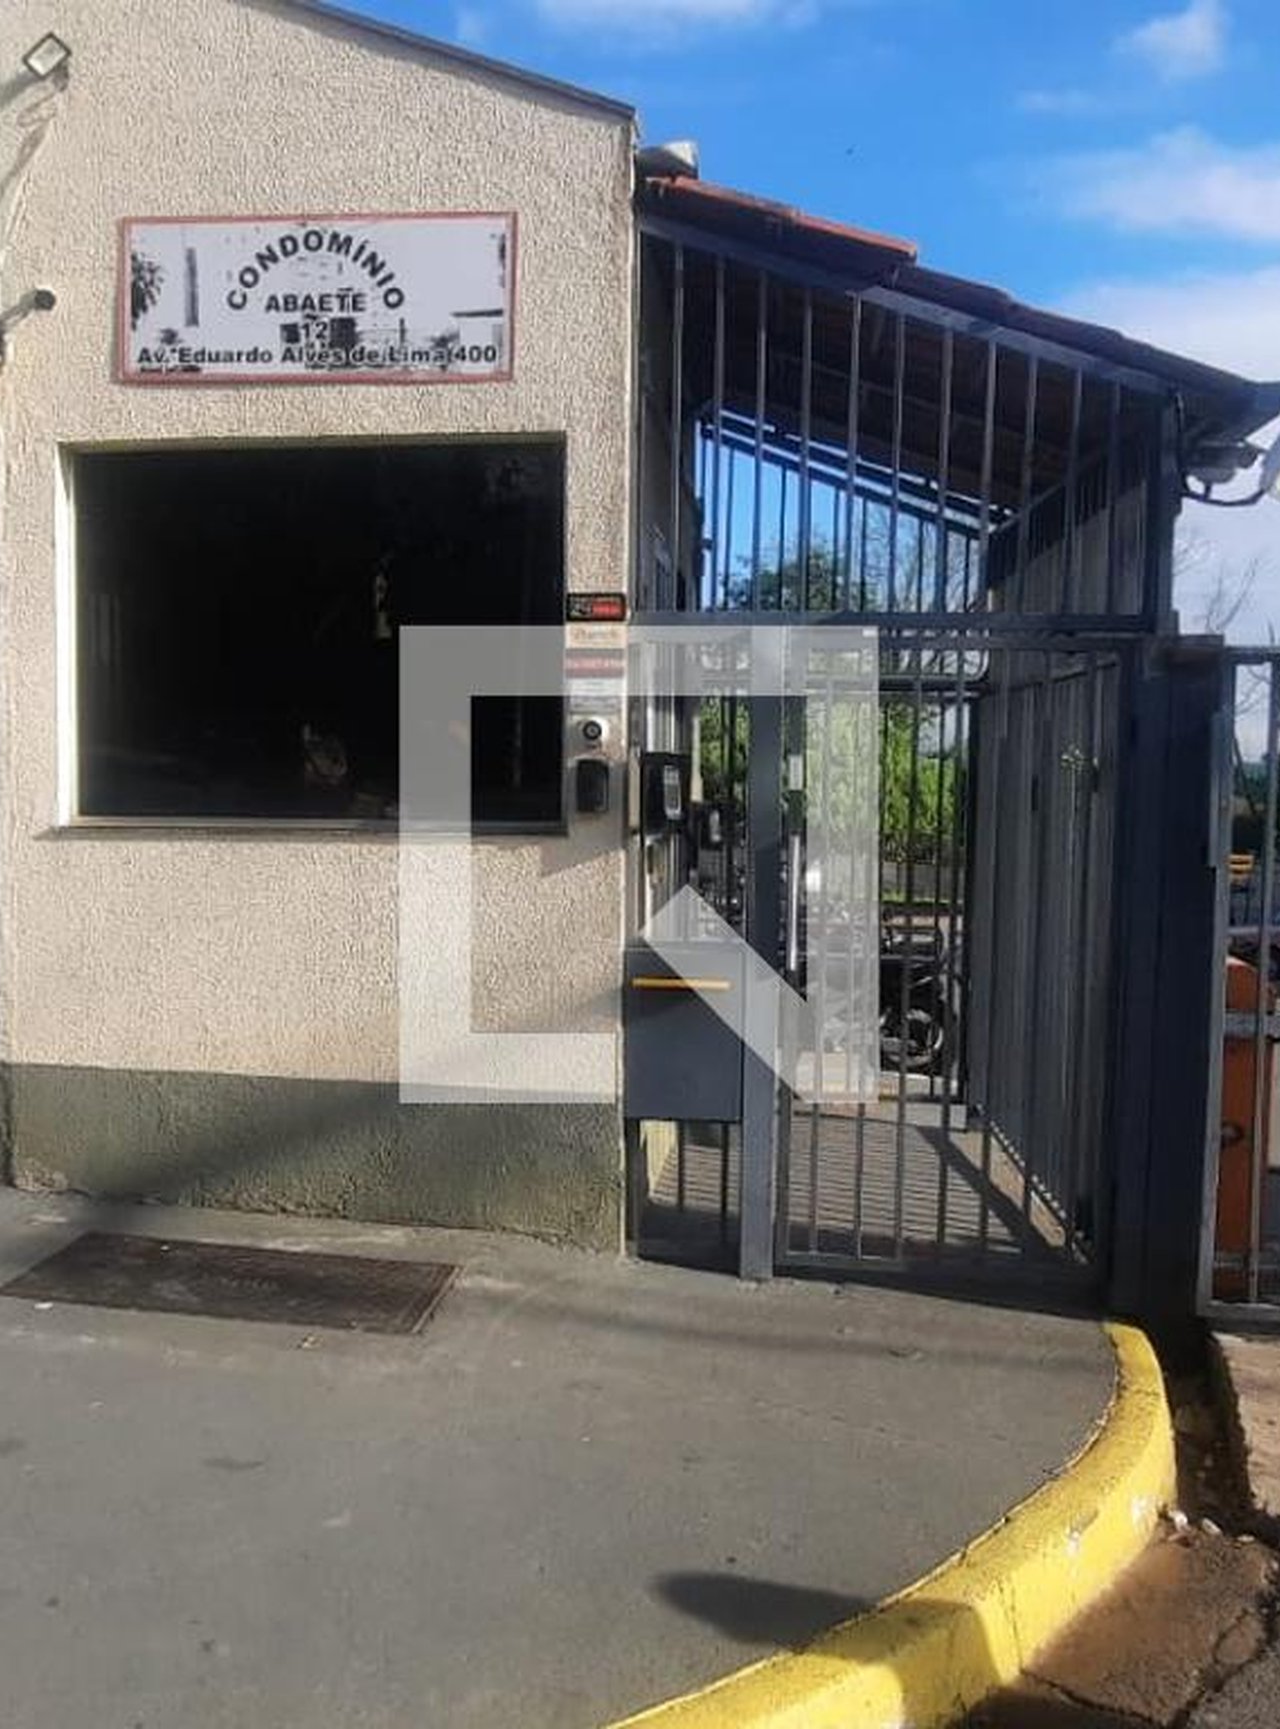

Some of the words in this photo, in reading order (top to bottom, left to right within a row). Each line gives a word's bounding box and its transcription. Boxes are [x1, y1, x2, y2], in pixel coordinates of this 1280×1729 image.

[227, 229, 404, 309] CONDOMÍNIO
[178, 346, 273, 363] Eduardo
[281, 346, 343, 363] Alves
[352, 346, 379, 363] de
[455, 345, 497, 363] 400
